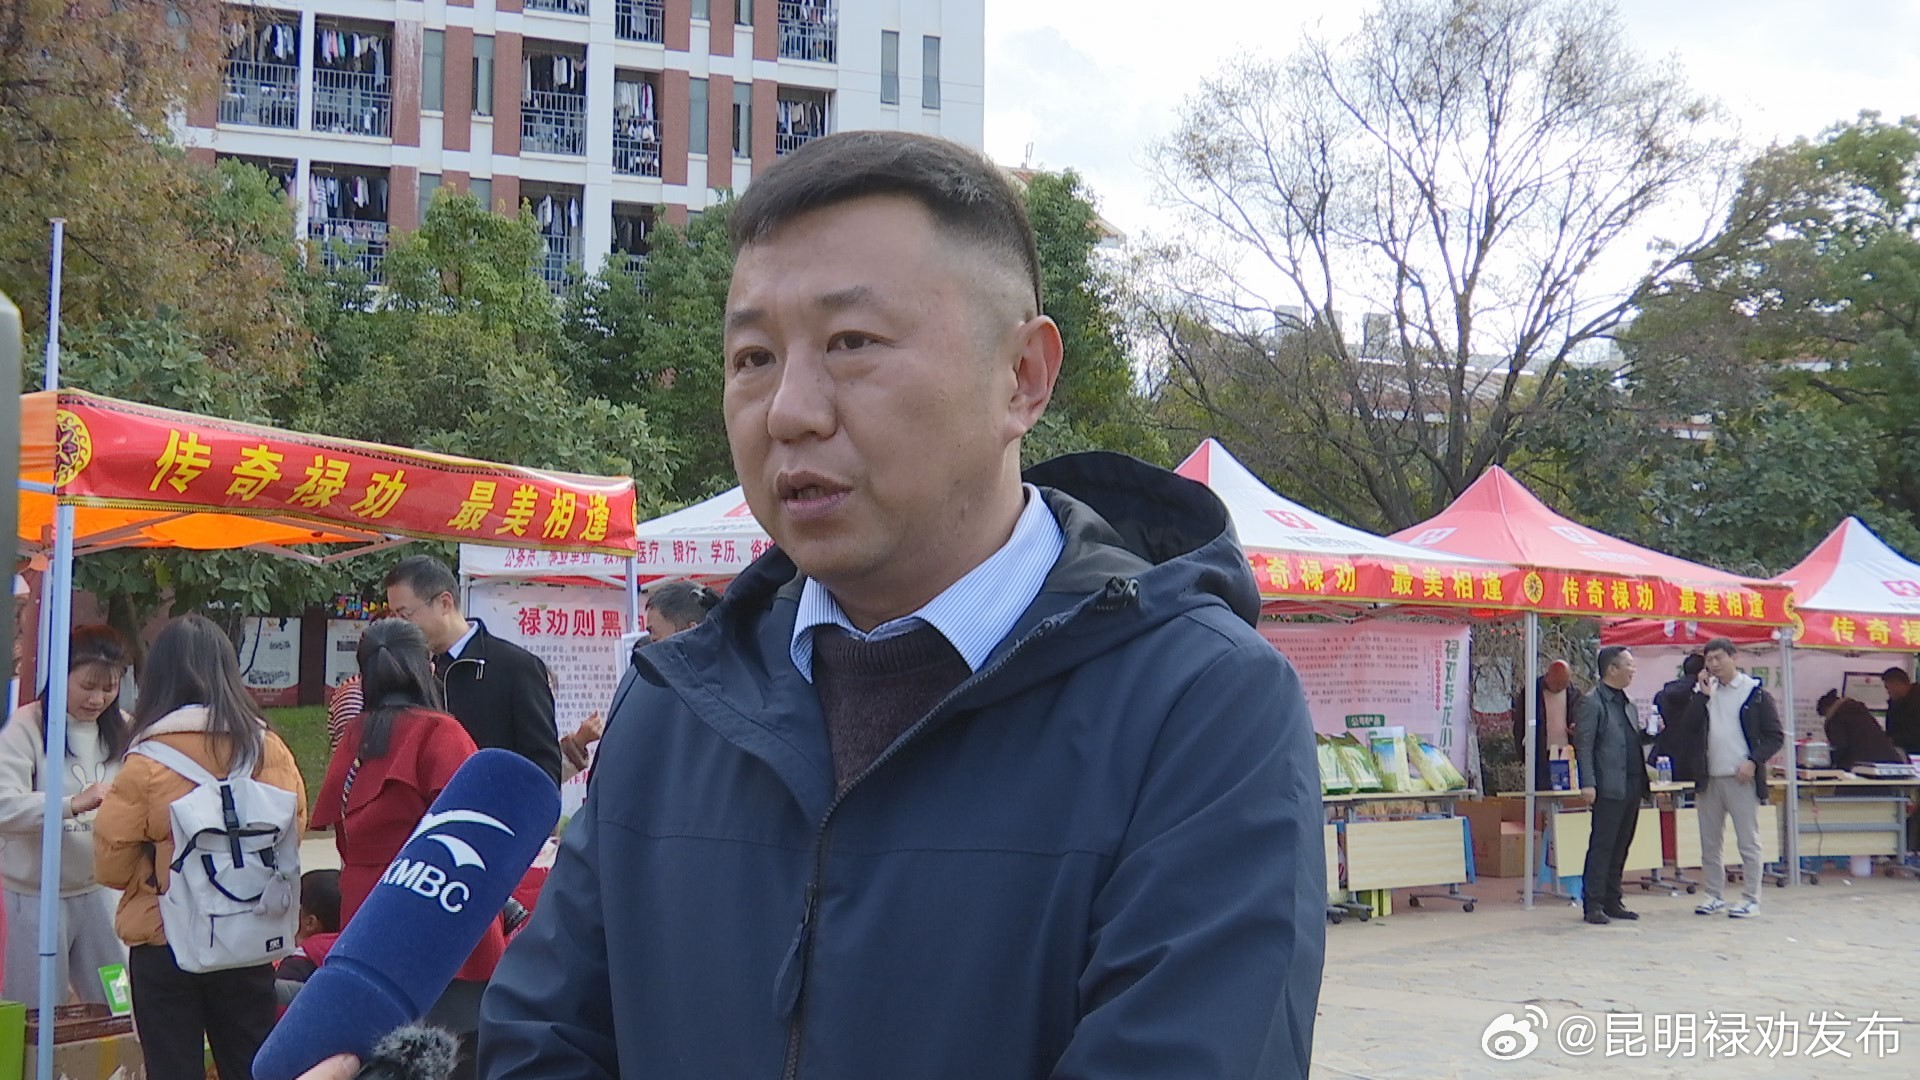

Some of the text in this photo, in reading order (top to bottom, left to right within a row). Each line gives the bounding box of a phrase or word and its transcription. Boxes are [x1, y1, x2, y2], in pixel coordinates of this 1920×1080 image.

[148, 429, 614, 542] 传奇禄劝 最美相逢
[1391, 563, 1504, 601] 最美相逢
[1561, 576, 1766, 619] 传奇禄劝 最美相逢
[518, 607, 646, 637] 禄劝则黑
